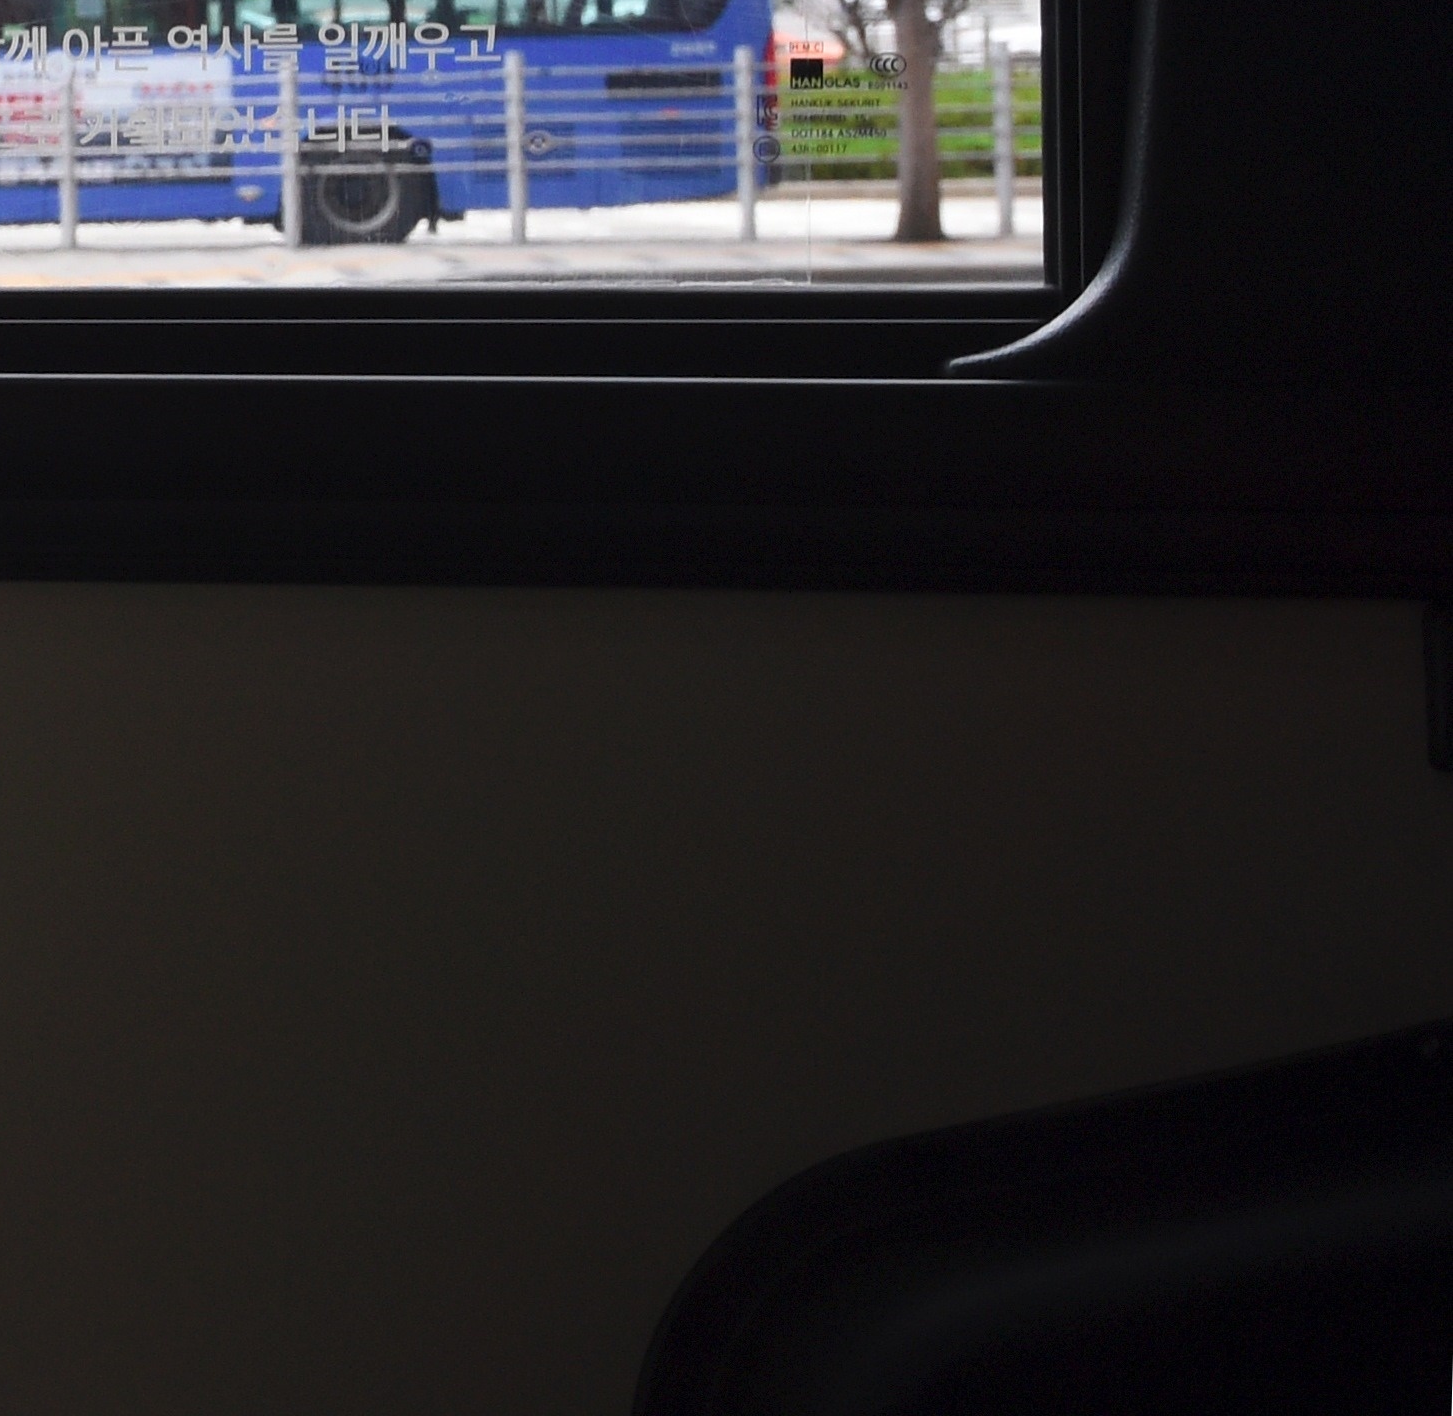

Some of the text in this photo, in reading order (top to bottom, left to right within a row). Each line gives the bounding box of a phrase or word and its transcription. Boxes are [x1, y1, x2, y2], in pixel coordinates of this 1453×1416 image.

[61, 24, 151, 72] 아픈
[166, 22, 305, 71] 역사를
[316, 20, 502, 70] 일깨우고
